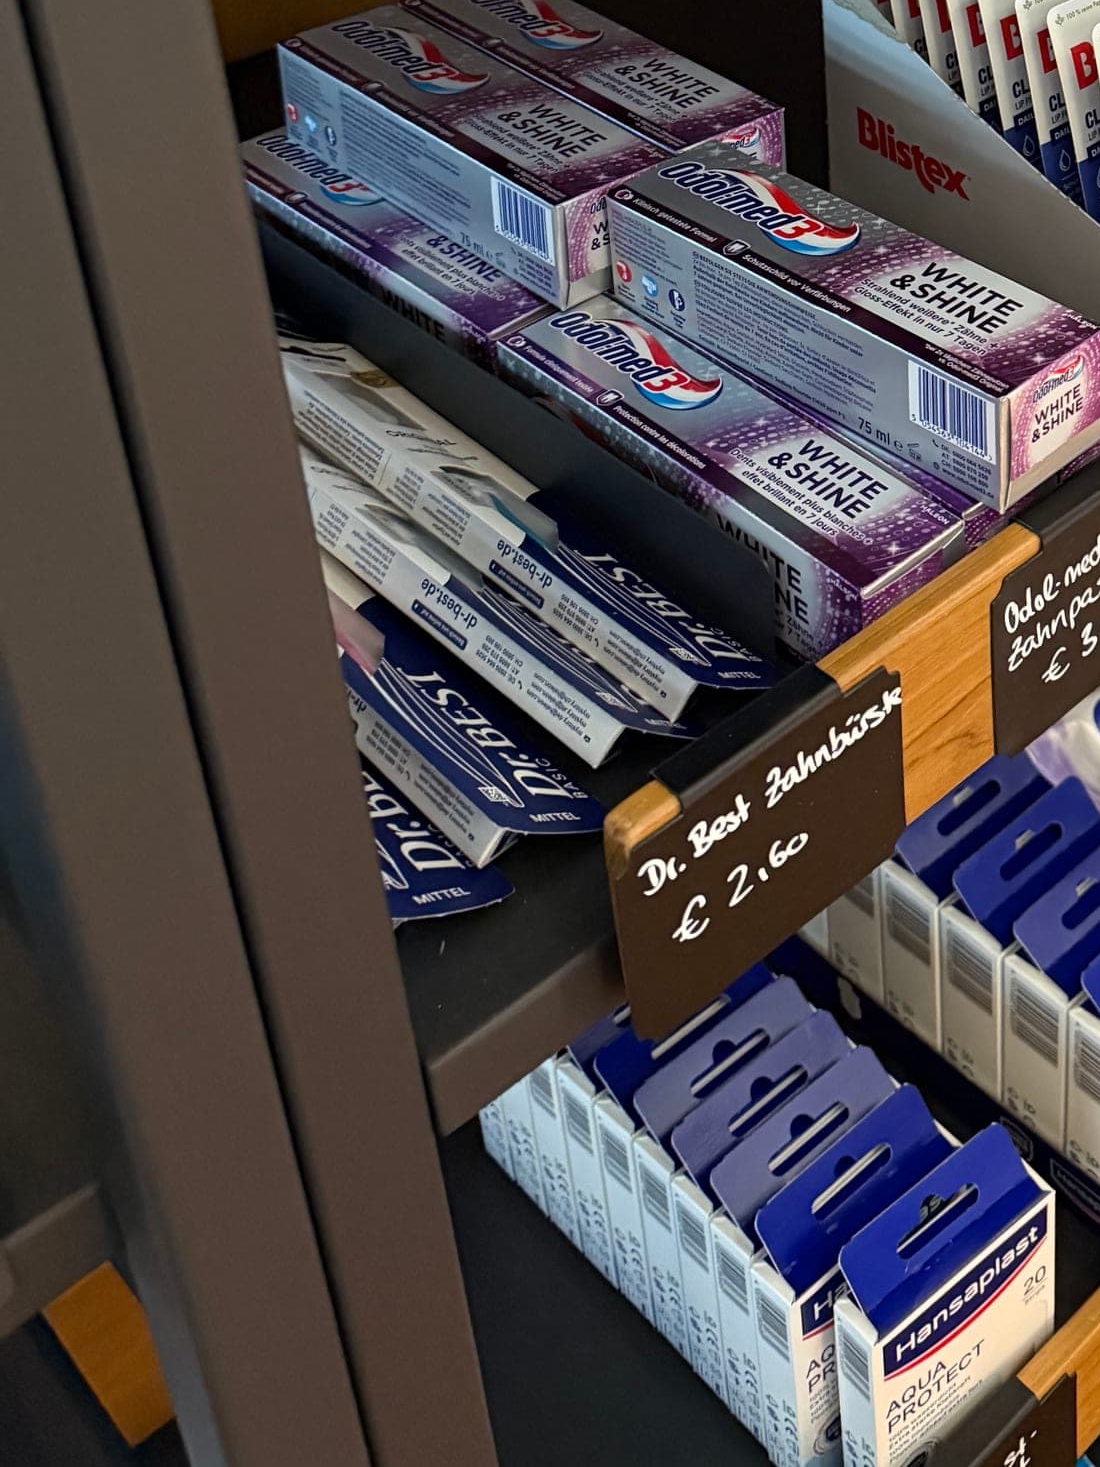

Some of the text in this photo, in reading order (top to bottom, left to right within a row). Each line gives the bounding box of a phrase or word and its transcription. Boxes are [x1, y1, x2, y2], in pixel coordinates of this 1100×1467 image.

[644, 57, 721, 99] WHITE
[528, 103, 609, 148] WHITE
[856, 106, 971, 202] Blistex
[861, 278, 989, 346] Strahlend Zähne
[920, 261, 1024, 318] WHITE
[854, 285, 914, 320] Gloss-Effekt
[922, 319, 944, 335] nur
[953, 333, 987, 358] Tagen
[857, 416, 891, 446] 75 ml
[1034, 384, 1082, 426] WHITE
[730, 447, 825, 515] Dents visiblement plus
[799, 438, 889, 501] WHITE
[741, 469, 762, 487] effet
[759, 481, 795, 512] brillant
[793, 504, 808, 516] en
[811, 515, 837, 538] jours
[497, 538, 553, 590] dr-best.de
[420, 577, 478, 631] dr-best.de
[1041, 645, 1072, 685] €
[396, 666, 517, 750] BEST
[528, 811, 581, 825] MITTEL
[636, 855, 688, 897] Dr.
[686, 793, 752, 860] Best
[411, 886, 472, 906] MITTEL
[671, 831, 810, 944] € 2,60
[894, 1225, 1039, 1363] Hansaplast
[1022, 1264, 1047, 1297] 20
[886, 1360, 947, 1420] AQUA
[888, 1338, 986, 1434] PROTECT
